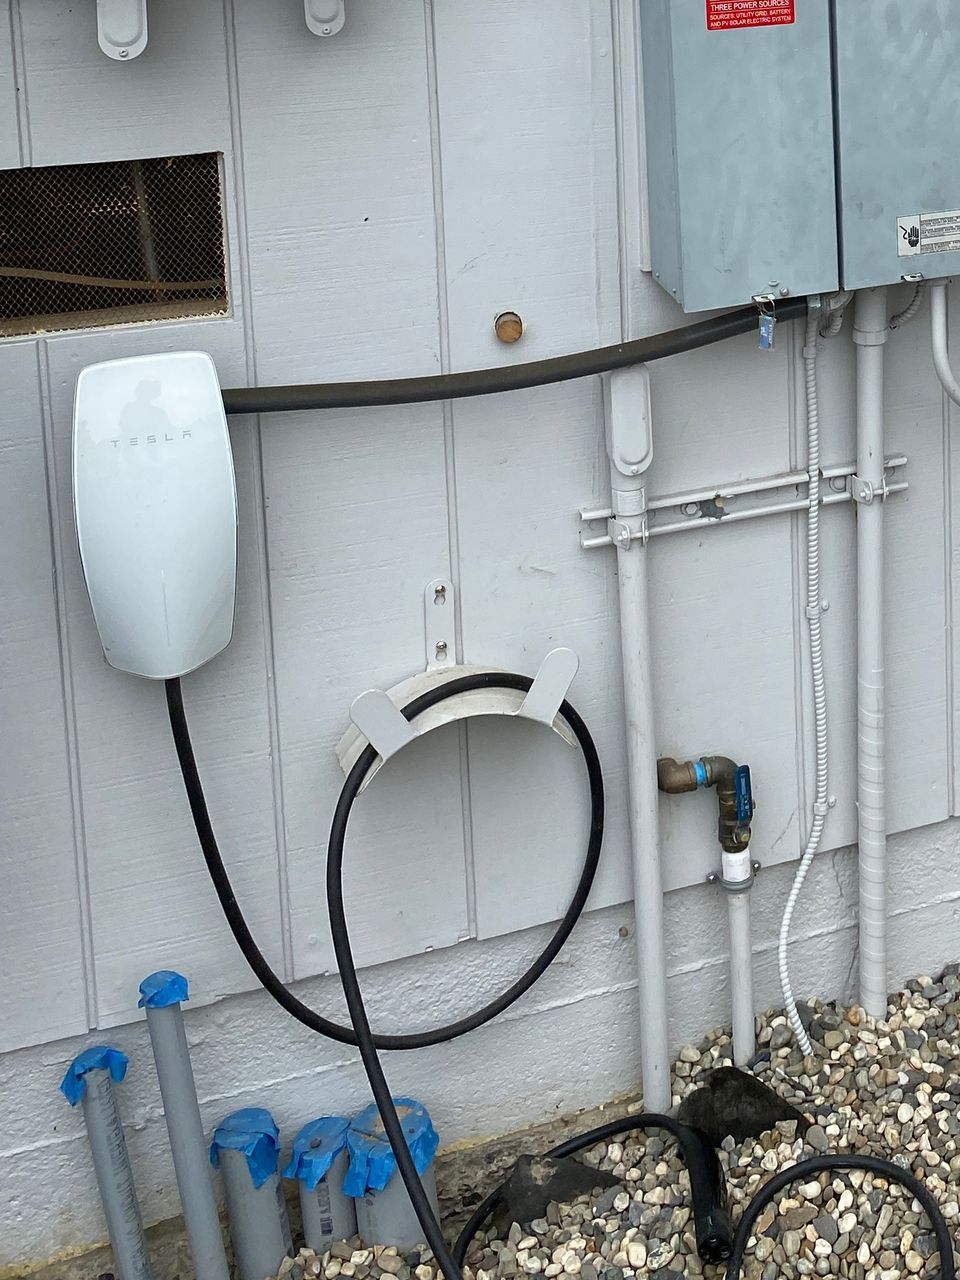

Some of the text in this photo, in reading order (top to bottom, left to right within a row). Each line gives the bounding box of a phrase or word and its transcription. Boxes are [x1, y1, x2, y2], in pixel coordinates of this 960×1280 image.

[711, 3, 732, 12] THREE
[733, 1, 758, 10] POWER
[769, 8, 791, 16] BATTERY
[111, 429, 192, 448] TESLA
